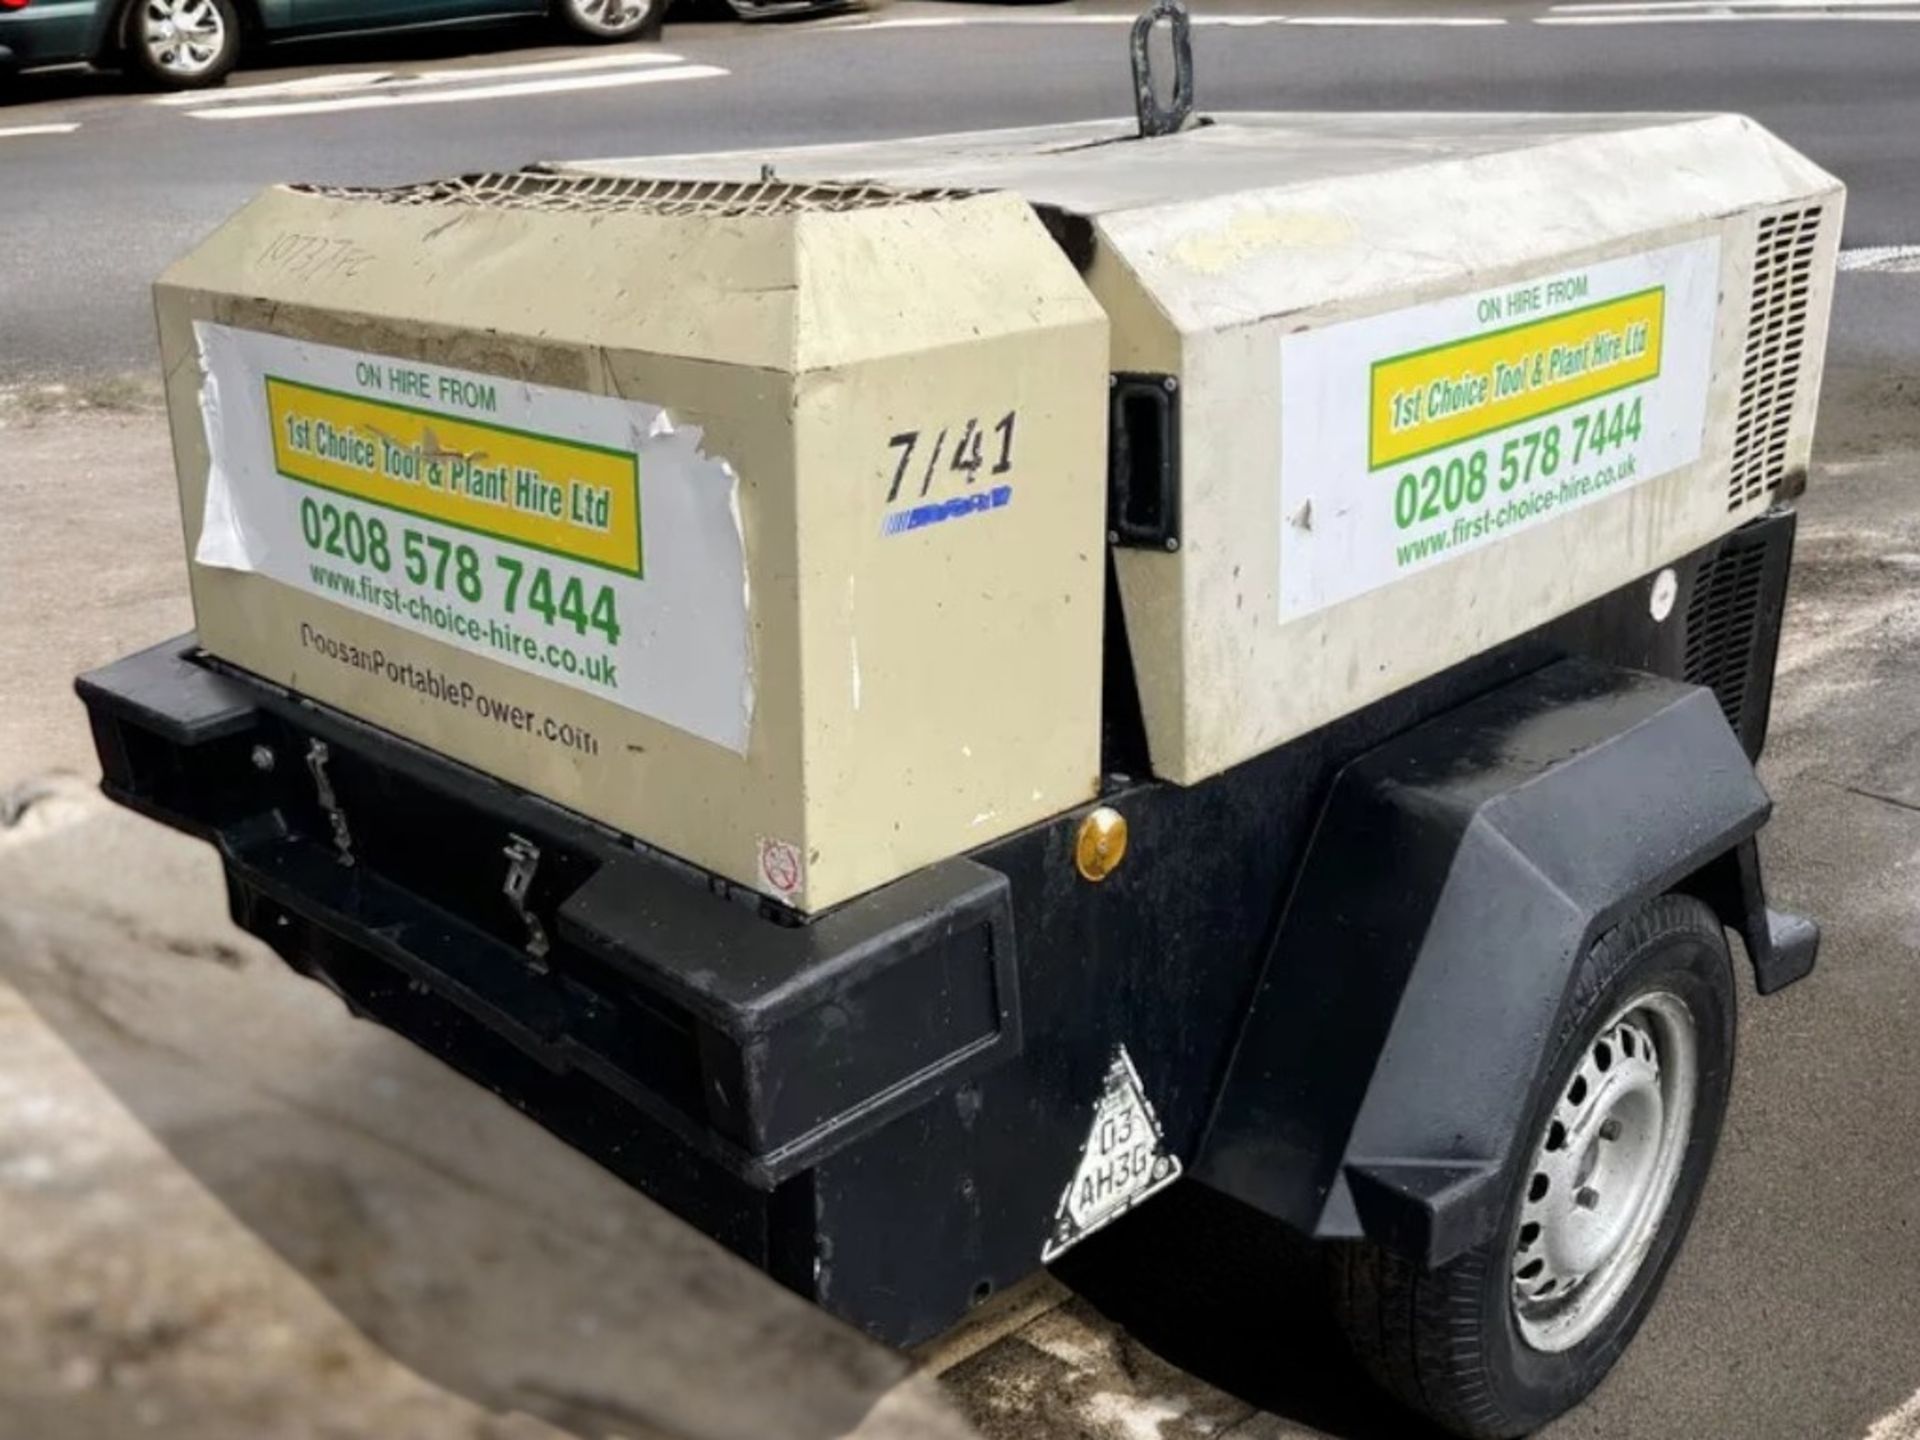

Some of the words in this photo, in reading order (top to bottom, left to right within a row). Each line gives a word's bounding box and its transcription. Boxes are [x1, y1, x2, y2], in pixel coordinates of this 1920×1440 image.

[1478, 300, 1501, 323] ON
[1507, 286, 1541, 316] HIRE
[1548, 275, 1589, 304] FROM
[356, 362, 382, 389] ON
[389, 368, 431, 398] HIRE
[438, 376, 496, 412] FROM
[1394, 389, 1421, 429] 1st
[1428, 374, 1488, 418] Choice
[1496, 358, 1527, 398] Tool
[1531, 353, 1543, 385] &
[1550, 341, 1590, 379] Plant
[1592, 333, 1621, 366] Hire
[1625, 322, 1648, 355] Ltd
[287, 416, 311, 450] 1st
[316, 421, 375, 469] Choice
[381, 439, 421, 480] Tool
[428, 462, 443, 486] &
[451, 460, 508, 503] Plant
[516, 470, 562, 516] Hire
[570, 483, 610, 528] Ltd
[886, 410, 1015, 504] 7/41
[1395, 449, 1487, 529] 0208
[1499, 424, 1560, 492] 578
[1572, 396, 1641, 465] 7444
[1396, 453, 1636, 567] www.first-choice-hire.co.uk
[302, 496, 391, 573] 0208
[404, 529, 482, 602] 578
[496, 555, 620, 646] 7444
[310, 563, 618, 688] www.first-choice-hire.co.uk
[301, 622, 599, 756] DoosanPortablePower.com
